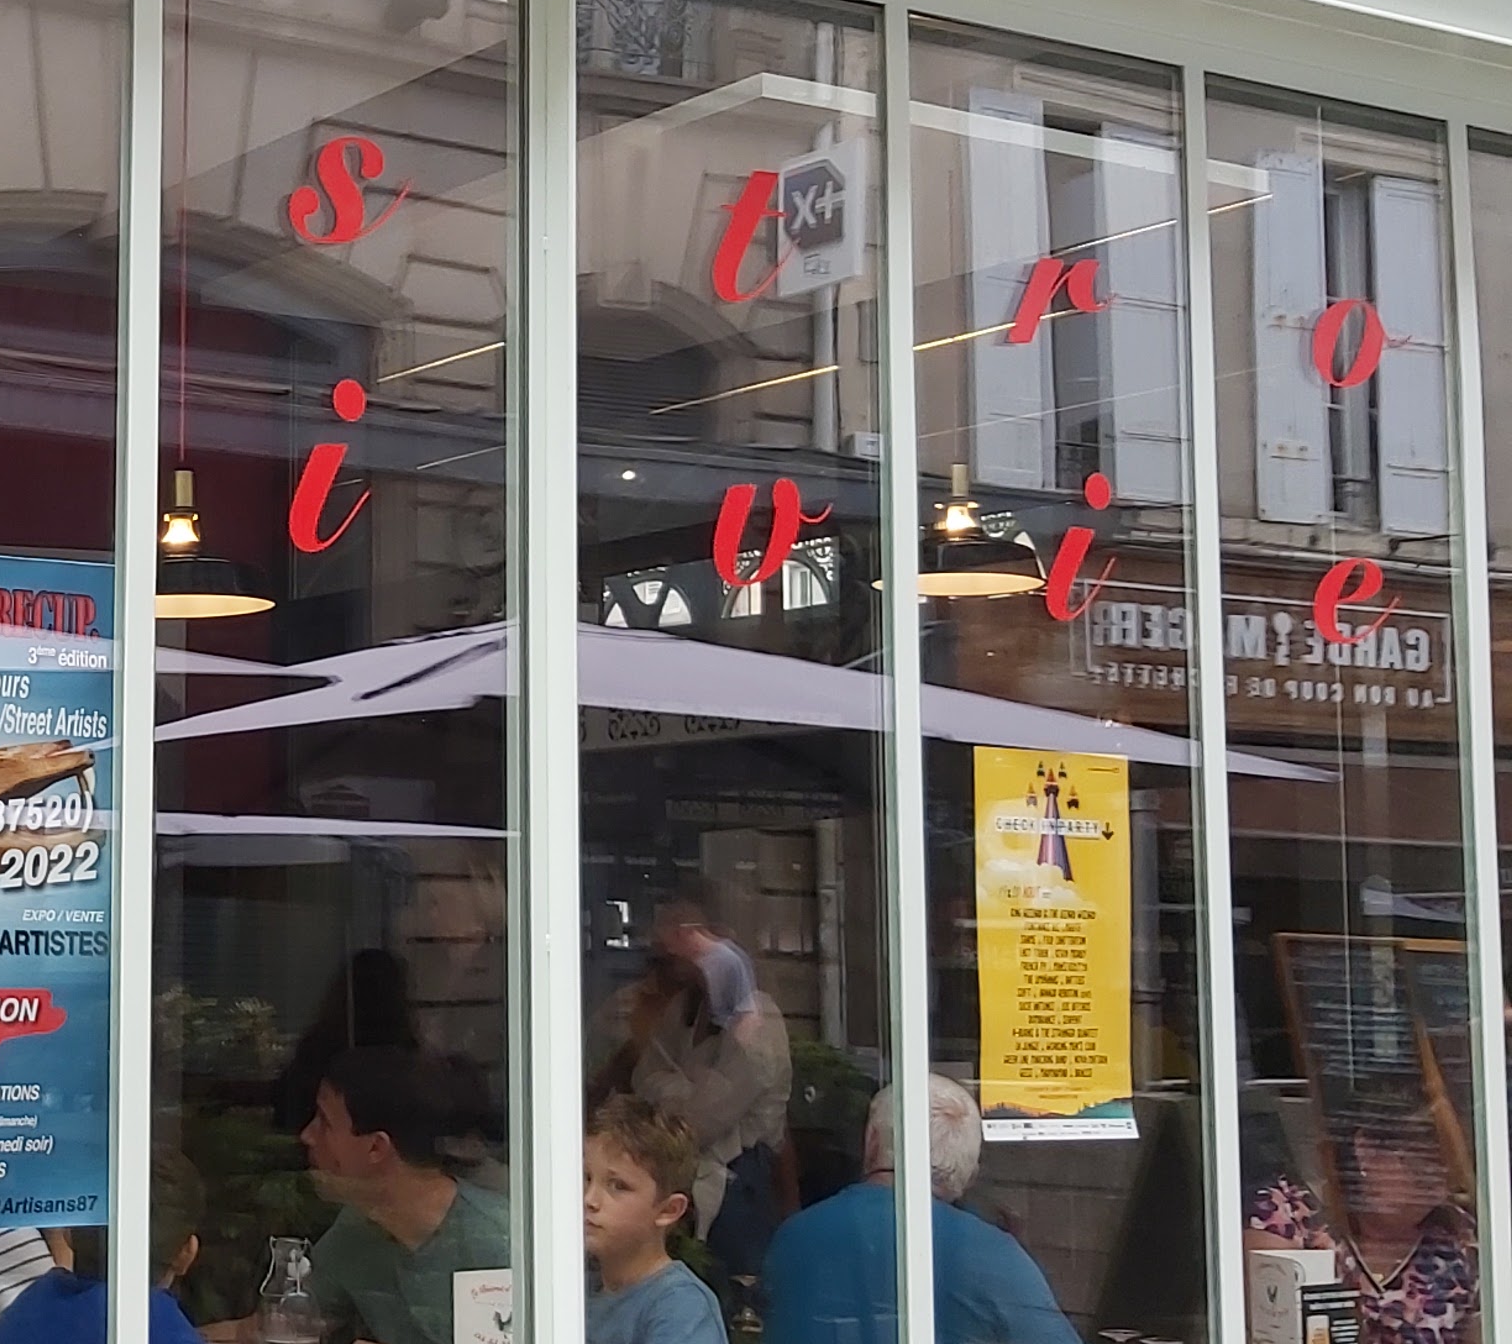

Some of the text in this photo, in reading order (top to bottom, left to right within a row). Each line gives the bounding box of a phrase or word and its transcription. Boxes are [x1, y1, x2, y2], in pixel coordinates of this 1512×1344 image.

[58, 647, 107, 668] édition
[54, 706, 107, 739] Artists
[22, 909, 56, 922] EXPO
[65, 910, 105, 924] VENTE
[25, 1135, 54, 1155] soir)
